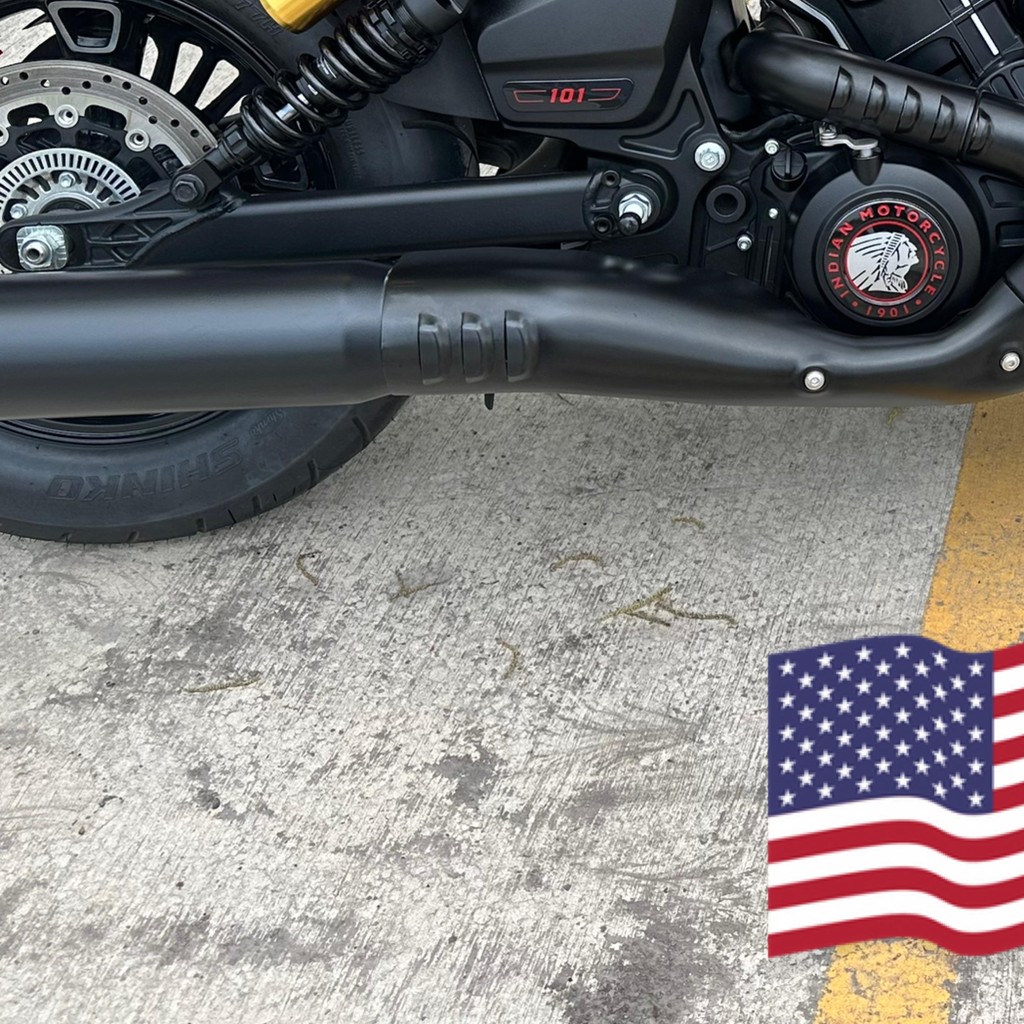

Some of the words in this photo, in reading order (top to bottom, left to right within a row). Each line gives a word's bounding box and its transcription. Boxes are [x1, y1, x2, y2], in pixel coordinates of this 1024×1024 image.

[550, 87, 586, 103] 101
[827, 222, 854, 299] INDIAN
[858, 205, 945, 295] MOTORCYCLE
[866, 305, 909, 318] 1901
[49, 438, 243, 502] SHINKO
